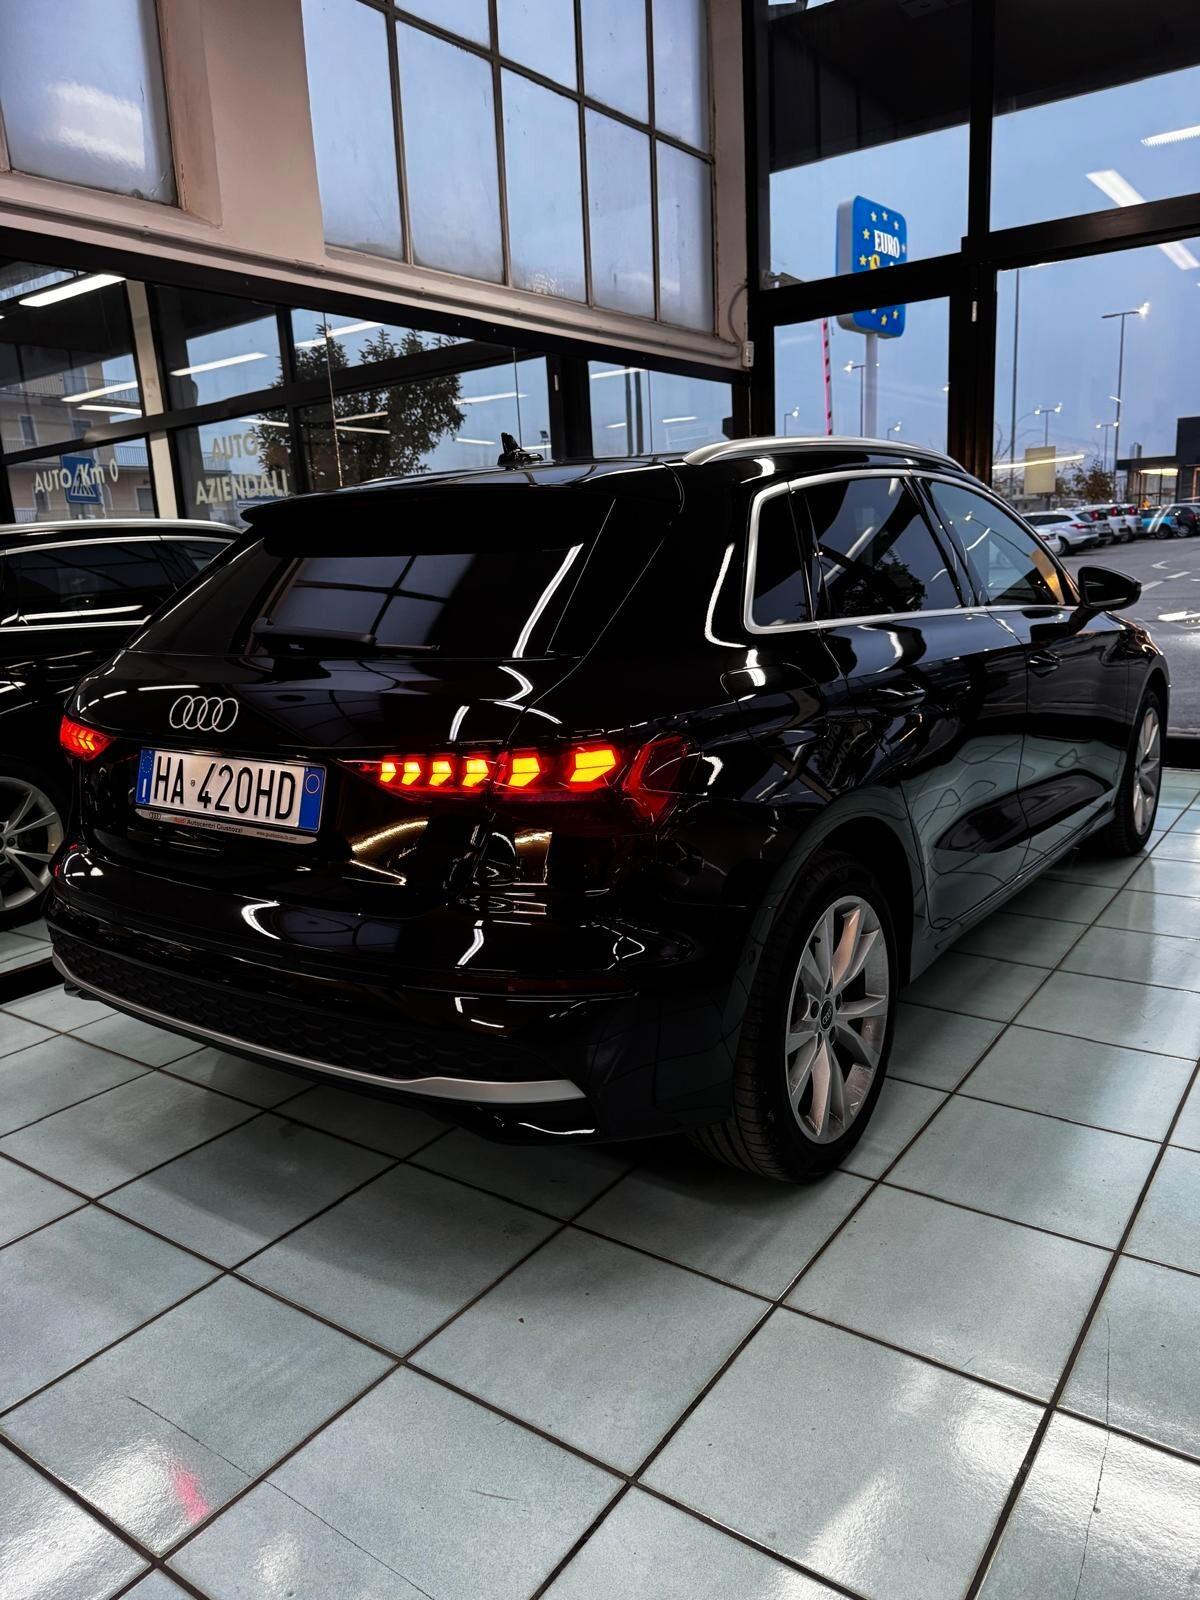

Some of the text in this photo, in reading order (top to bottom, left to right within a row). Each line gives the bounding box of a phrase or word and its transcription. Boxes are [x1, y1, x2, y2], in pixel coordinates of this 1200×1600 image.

[874, 230, 900, 258] EURO
[212, 432, 258, 460] AUTO
[35, 468, 72, 493] AUTO
[80, 463, 105, 487] Km
[196, 469, 288, 505] AZIENDALI
[154, 756, 184, 804] HA
[197, 763, 296, 820] 420HD
